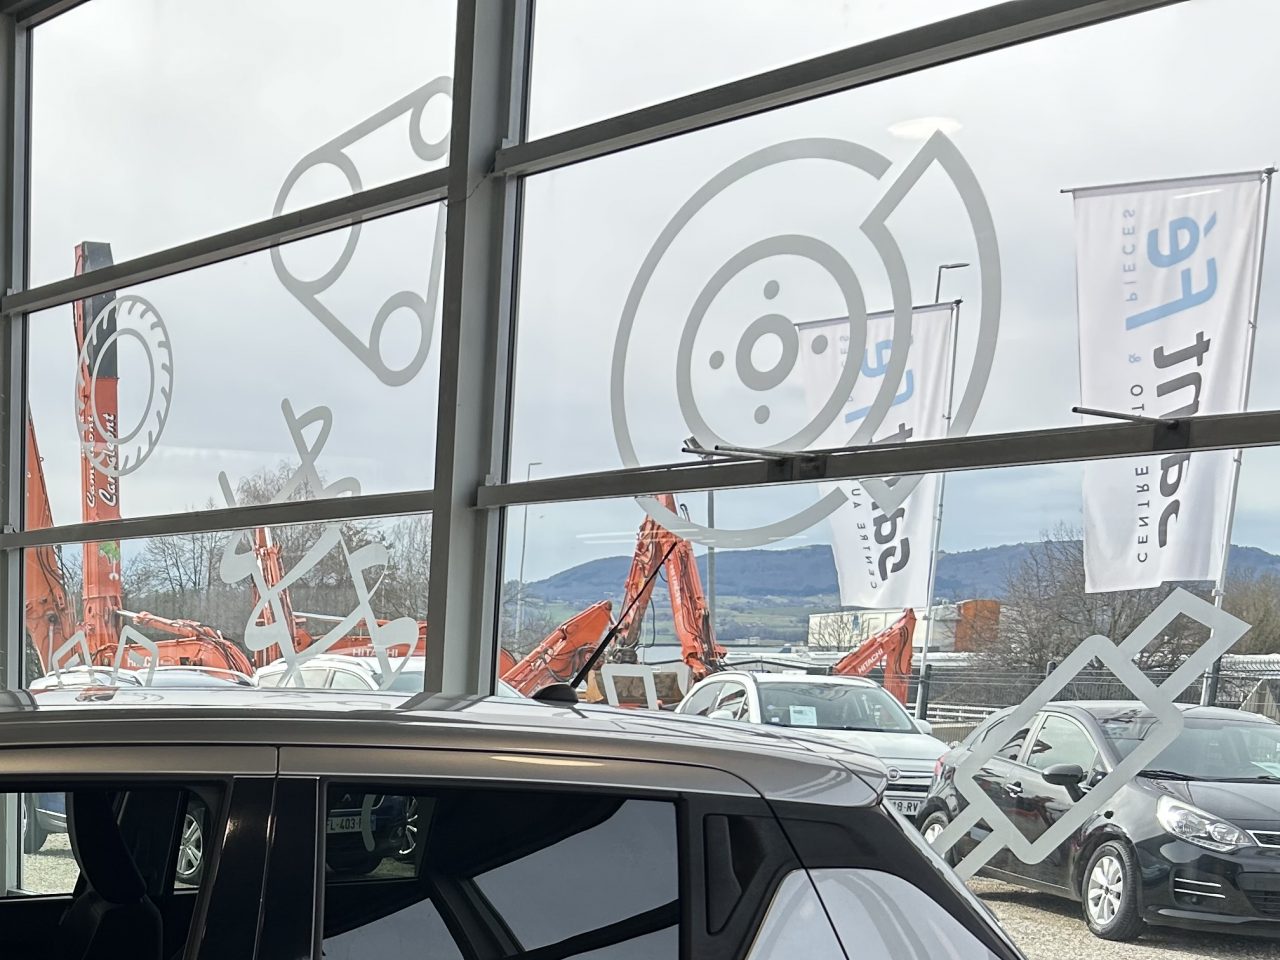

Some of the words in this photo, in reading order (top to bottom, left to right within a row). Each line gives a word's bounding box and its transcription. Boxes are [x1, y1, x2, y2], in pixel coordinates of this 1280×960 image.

[352, 648, 399, 657] HITAHI
[857, 648, 884, 675] HITACHI
[893, 801, 919, 812] 8-RV
